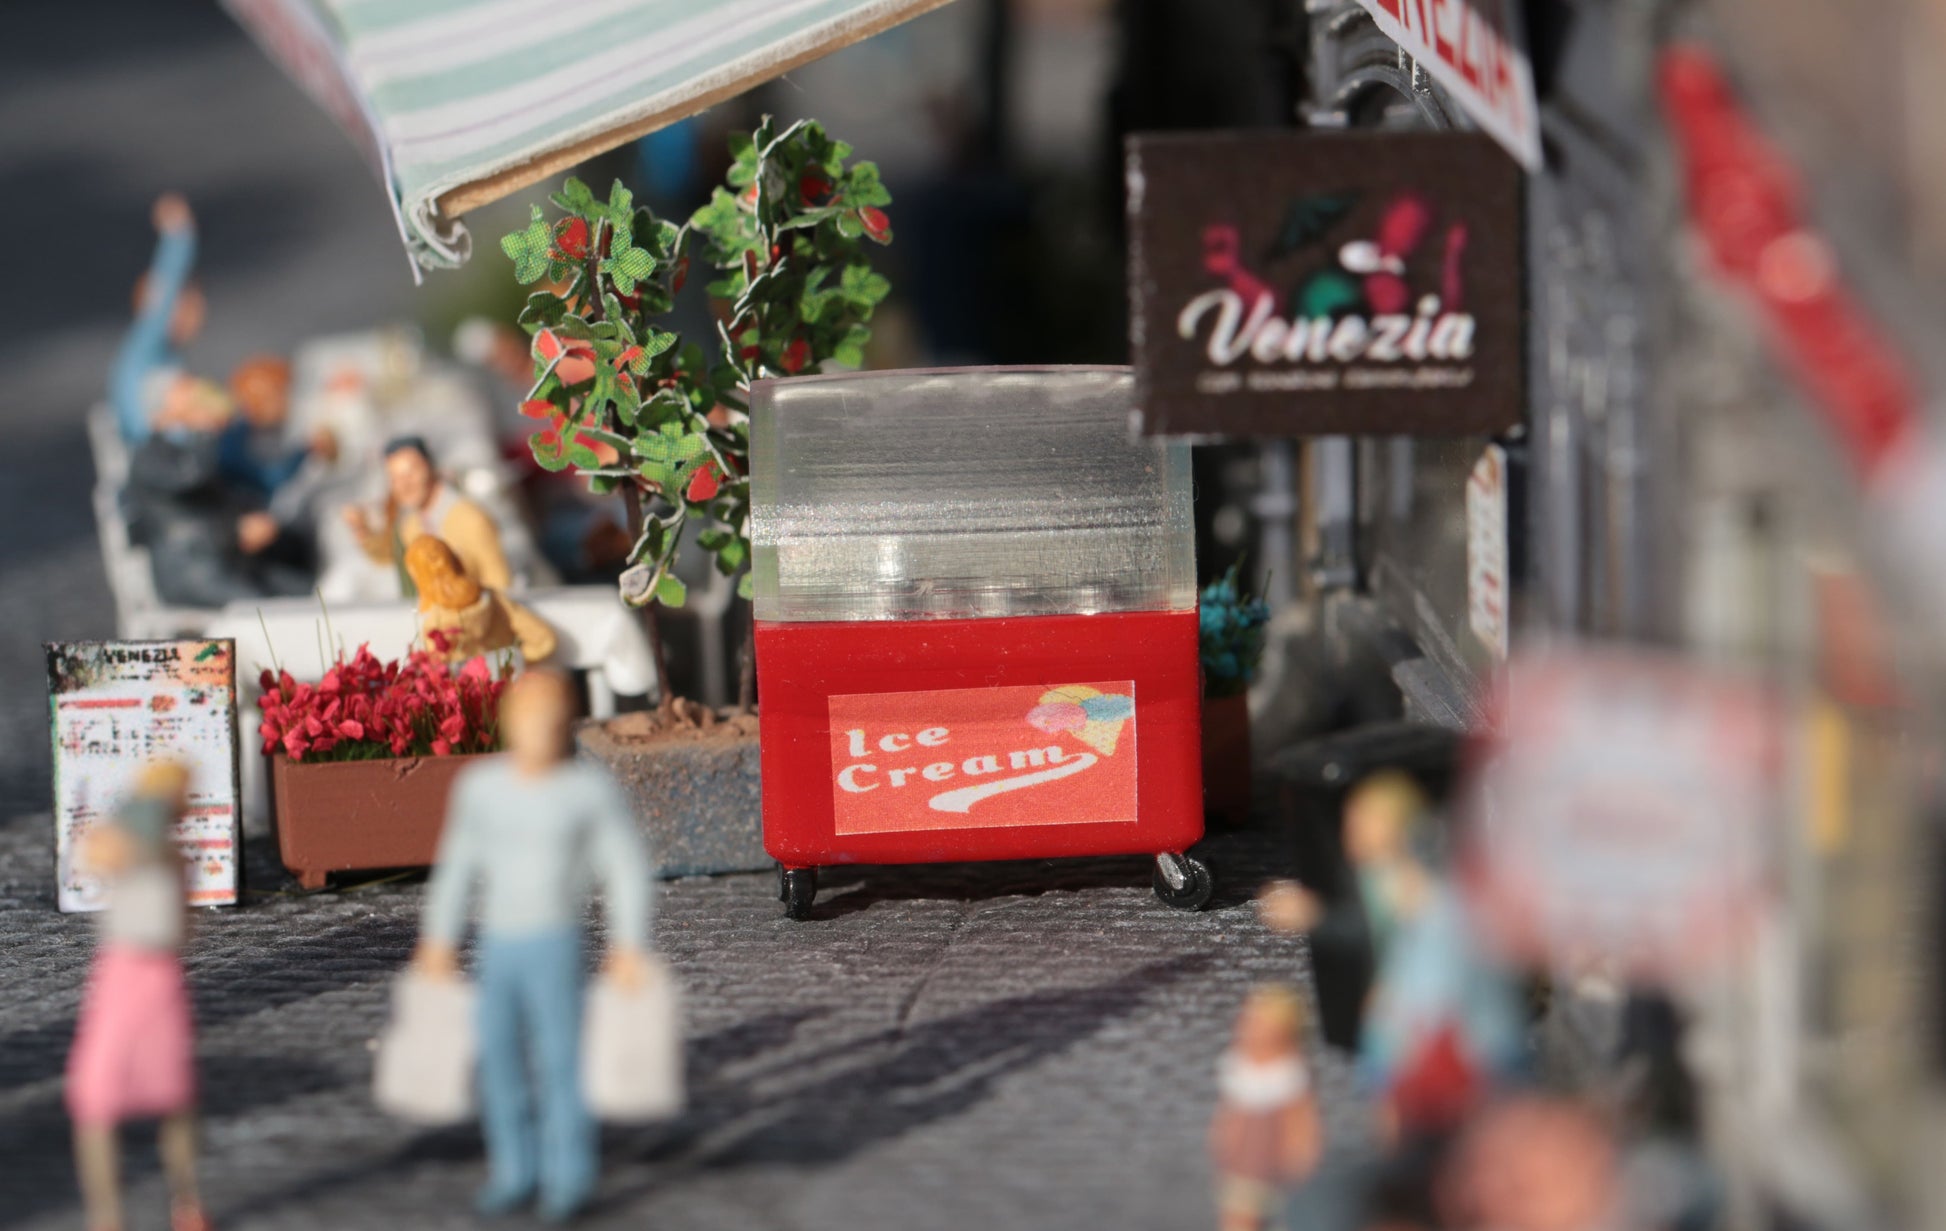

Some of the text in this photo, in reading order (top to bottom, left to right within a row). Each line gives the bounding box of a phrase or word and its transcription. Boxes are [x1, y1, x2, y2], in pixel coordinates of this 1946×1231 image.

[1177, 289, 1476, 366] Venezia
[845, 726, 950, 757] Ice
[837, 745, 1066, 793] Cream
